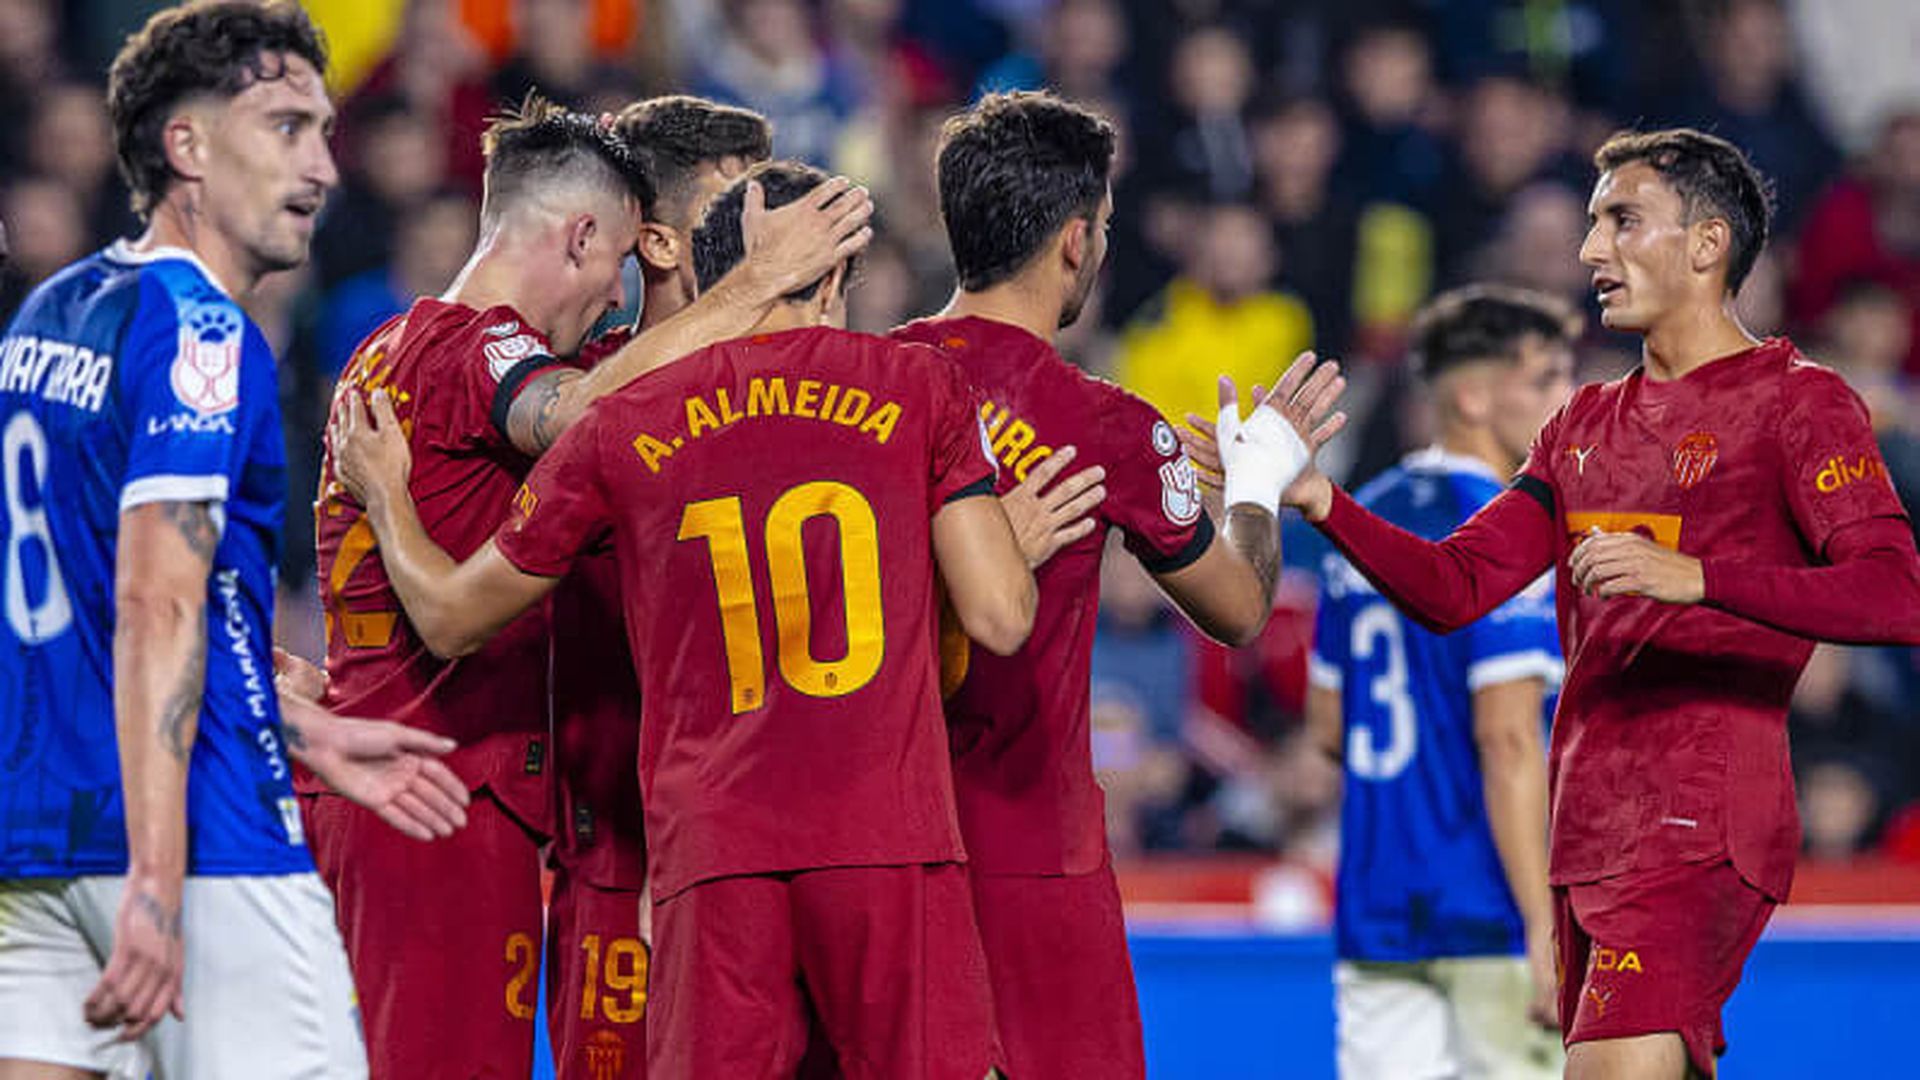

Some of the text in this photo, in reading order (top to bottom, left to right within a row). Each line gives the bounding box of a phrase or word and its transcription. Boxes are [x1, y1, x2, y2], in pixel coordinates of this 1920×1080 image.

[633, 378, 902, 474] A. ALMEIDA
[4, 410, 73, 645] 8
[677, 480, 885, 714] 10
[1348, 604, 1417, 779] 3
[580, 934, 648, 1023] 19
